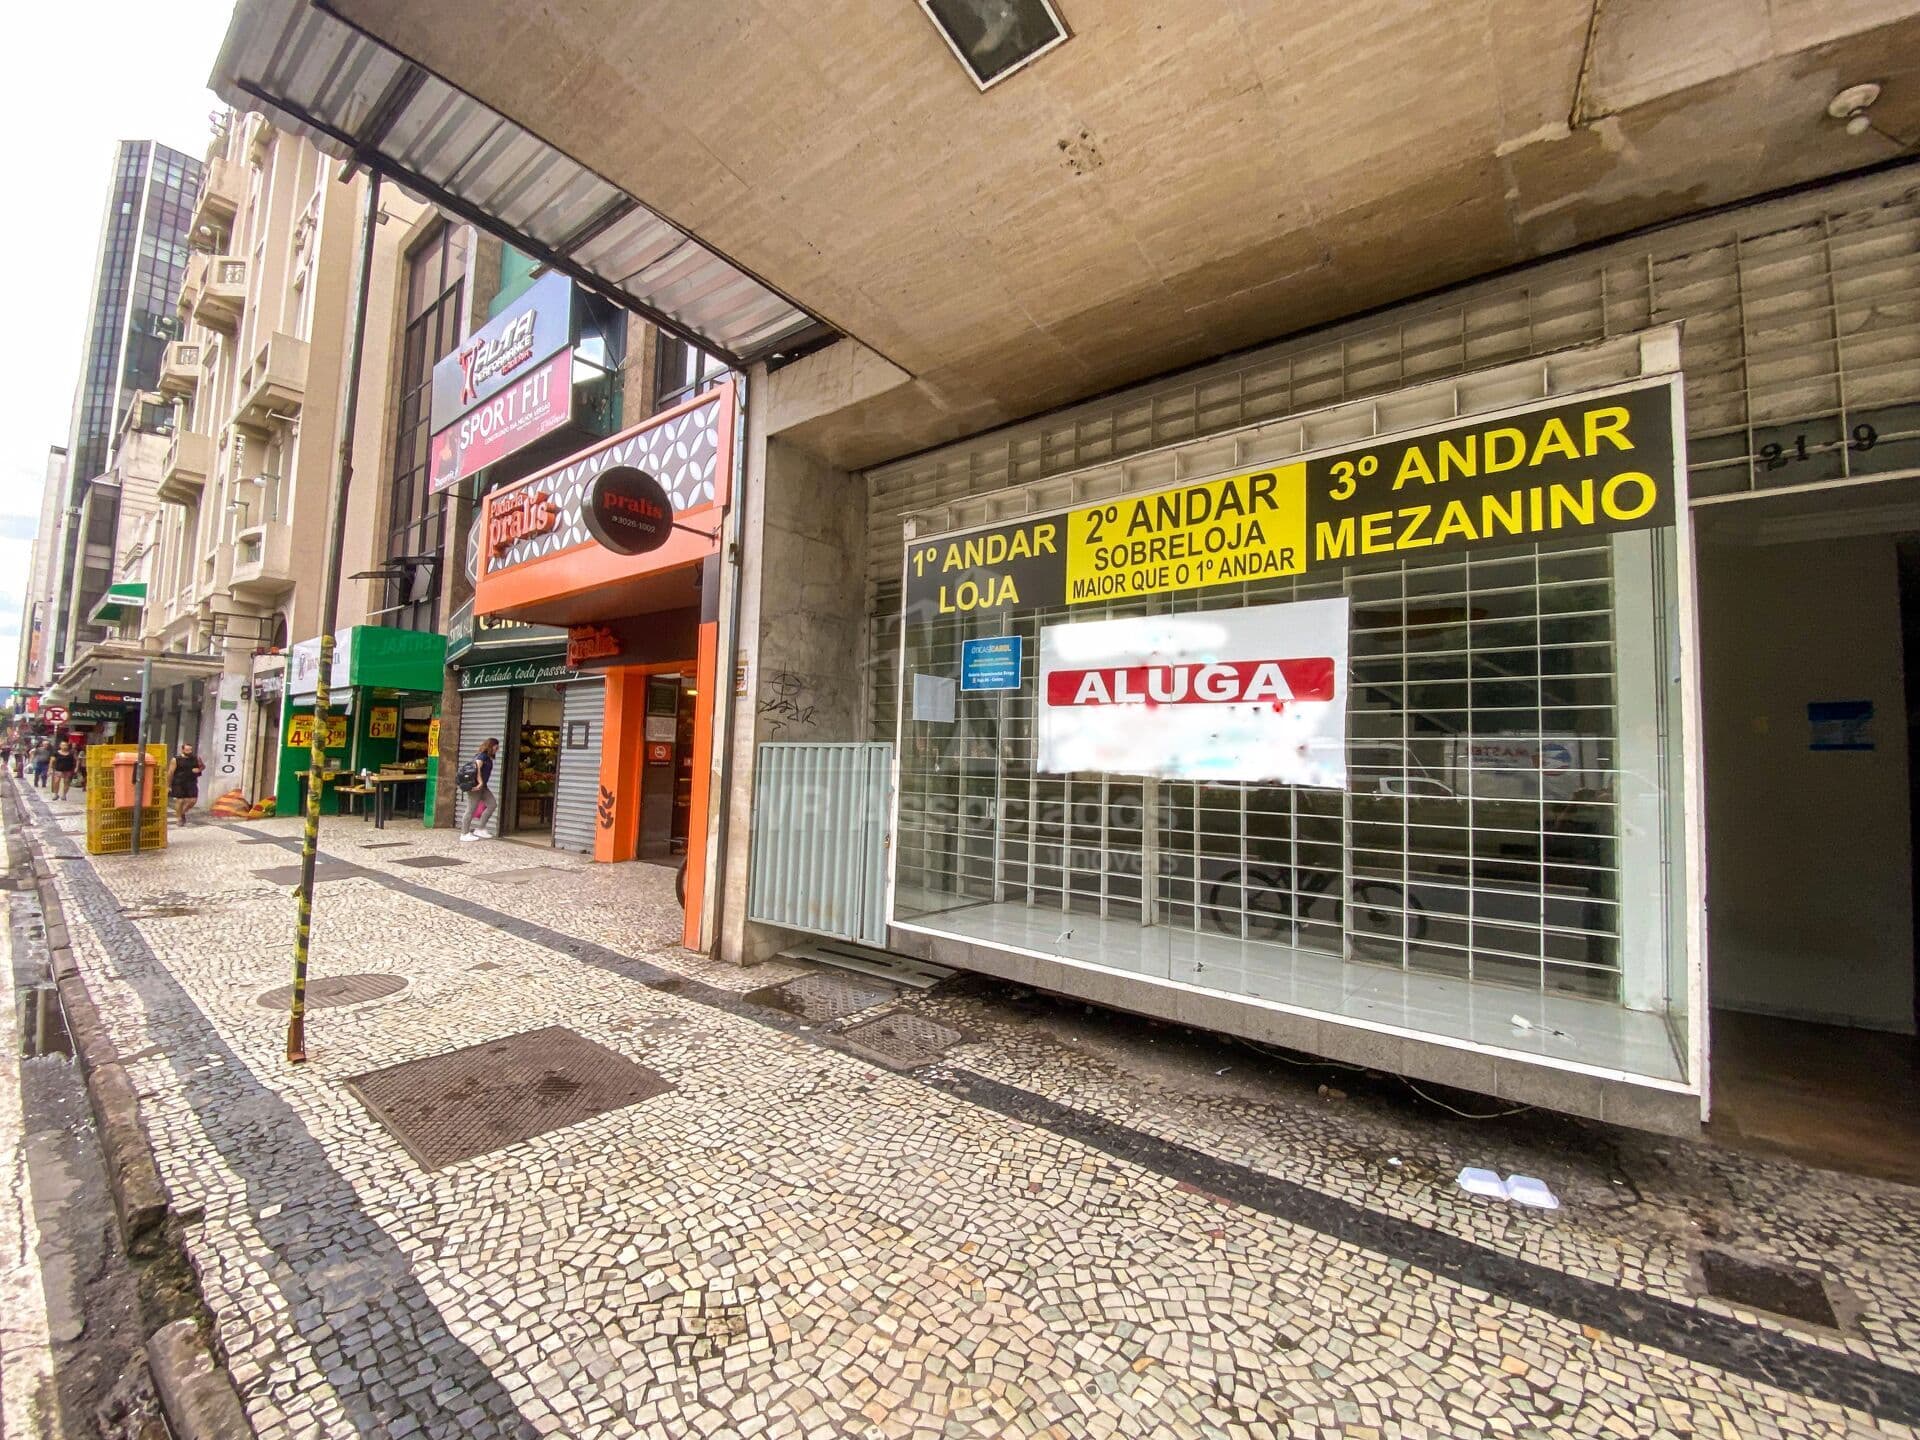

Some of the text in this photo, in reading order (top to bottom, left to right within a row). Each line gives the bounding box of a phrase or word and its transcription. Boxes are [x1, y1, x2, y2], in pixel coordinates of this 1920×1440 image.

[461, 389, 517, 450] SPORT
[522, 365, 553, 414] FIT
[1328, 406, 1636, 501] 3º ANDAR
[1085, 473, 1280, 545] 2º ANDAR
[1315, 471, 1658, 562] MEZANINO
[912, 523, 1058, 578] 1º ANDAR
[1072, 547, 1295, 600] MAIOR QUE O 1º ANDAR
[1094, 520, 1267, 572] SOBRELOJA
[938, 575, 1020, 615] LOJA
[474, 668, 484, 684] A
[484, 666, 513, 683] cidade
[514, 663, 536, 680] toda
[534, 665, 567, 684] passa
[1073, 662, 1296, 705] ALUGA
[221, 712, 239, 774] ABERTO
